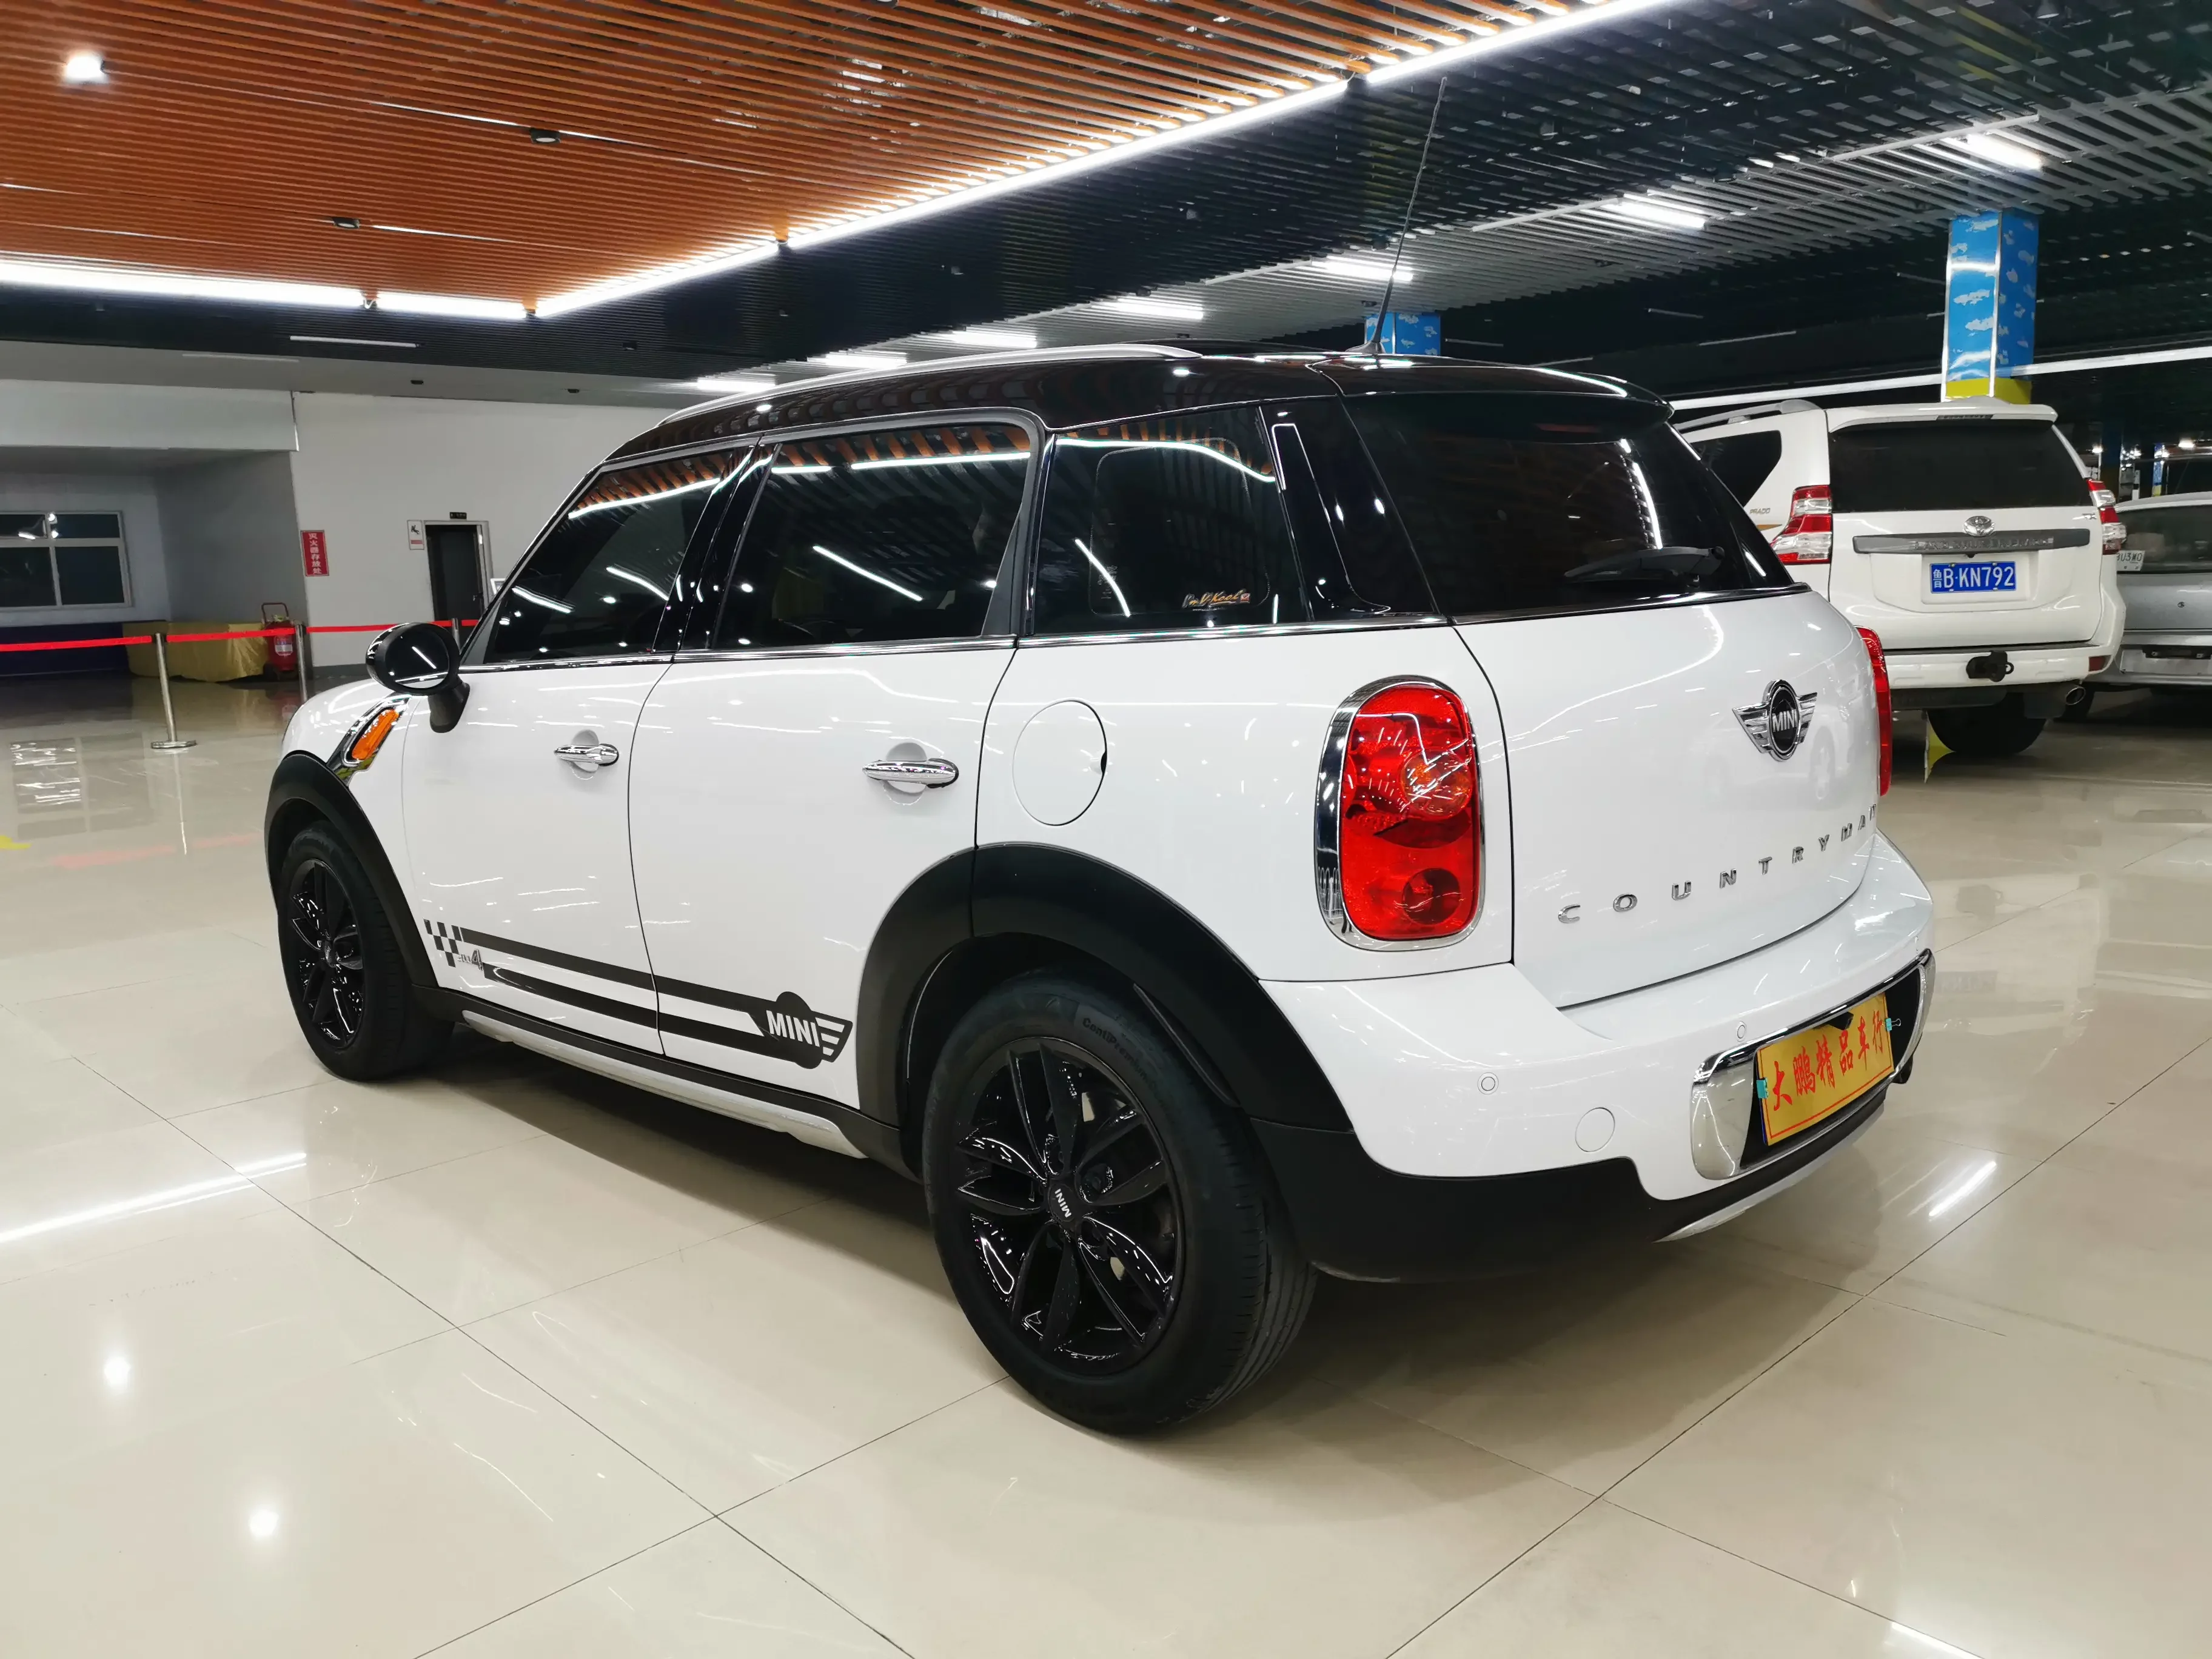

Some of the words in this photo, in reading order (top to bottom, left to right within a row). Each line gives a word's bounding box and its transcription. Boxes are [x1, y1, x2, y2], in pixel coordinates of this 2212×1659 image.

[1772, 709, 1798, 732] MINI
[766, 1010, 820, 1047] MINI
[1772, 1010, 1884, 1111] 大鹏精品车行
[1054, 1188, 1071, 1218] MINI
